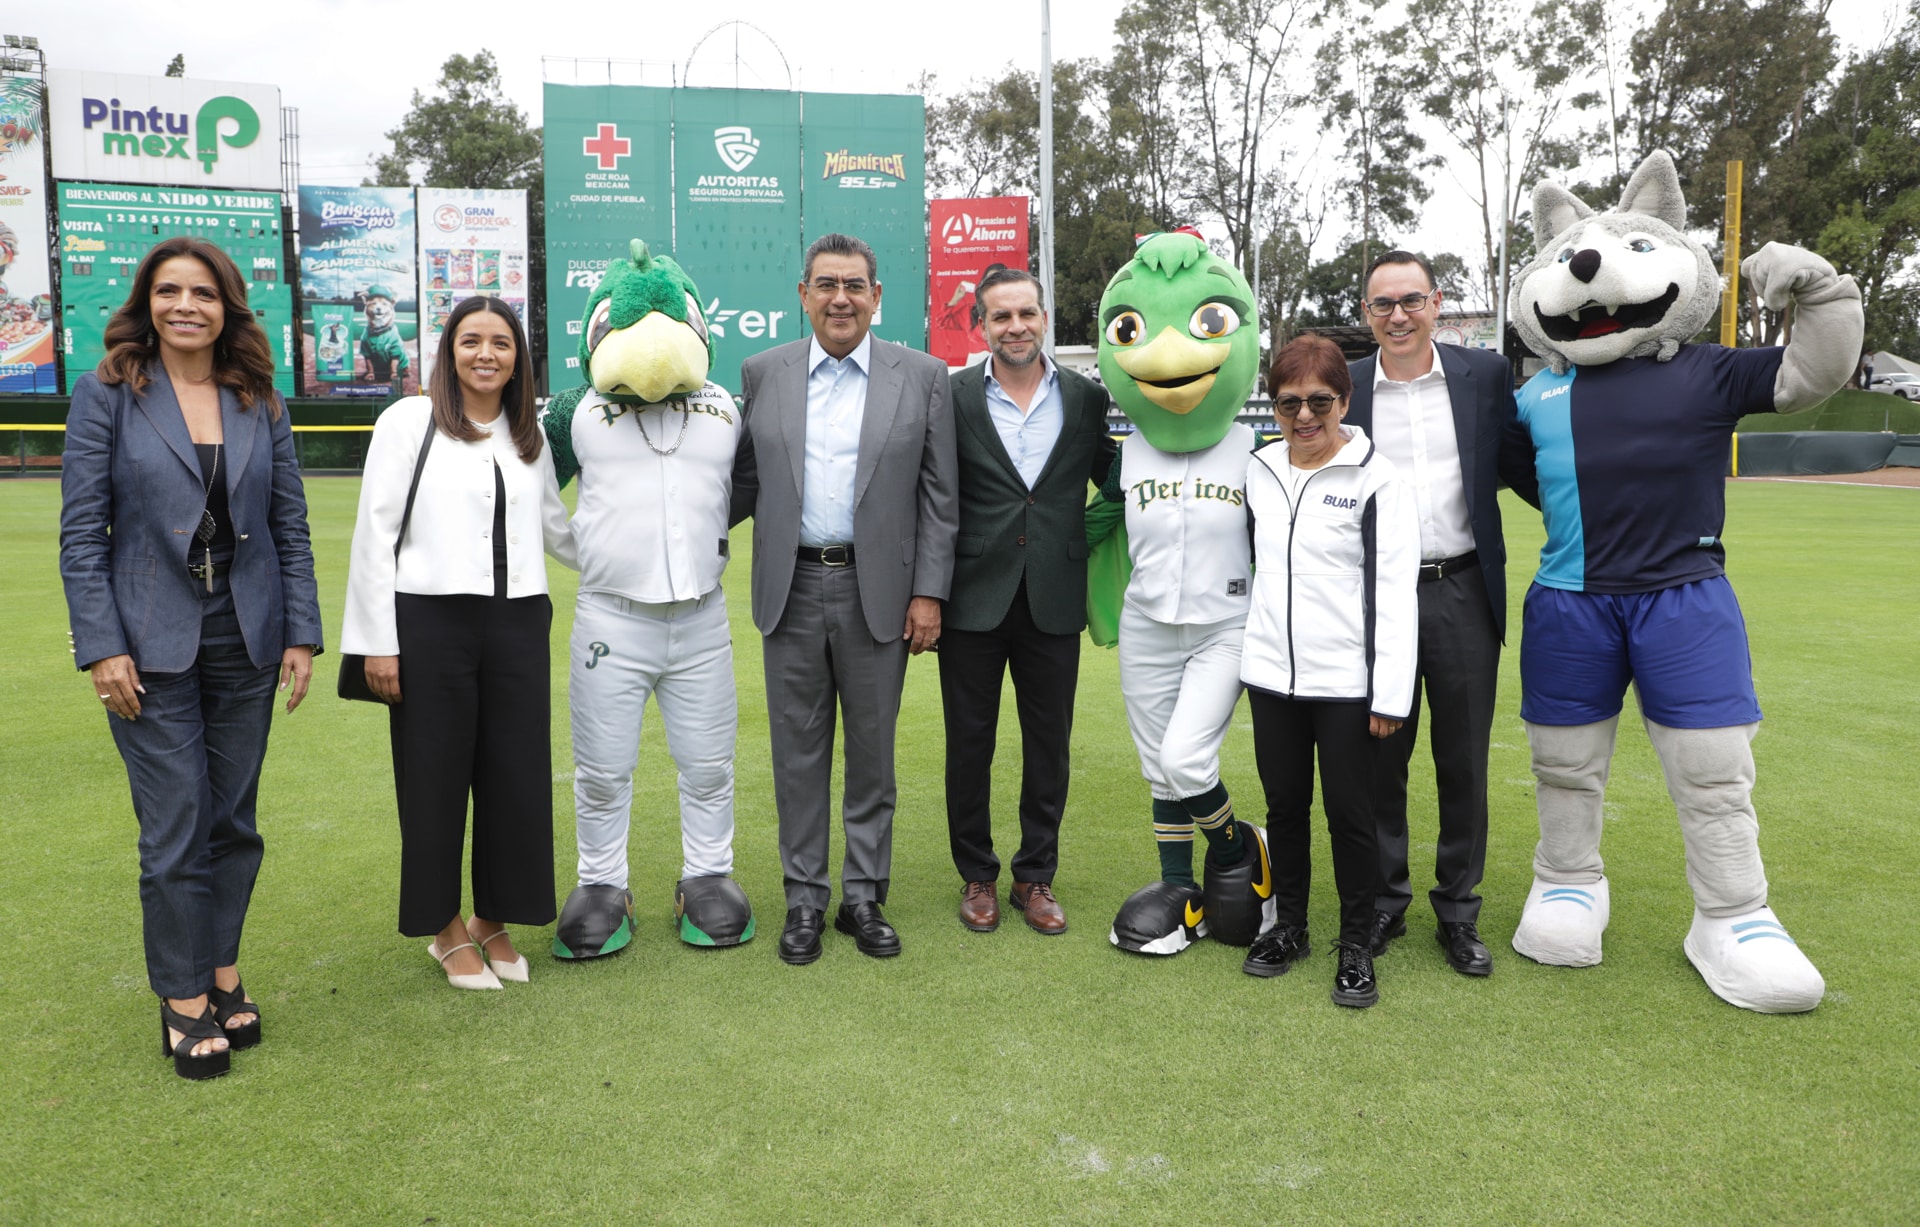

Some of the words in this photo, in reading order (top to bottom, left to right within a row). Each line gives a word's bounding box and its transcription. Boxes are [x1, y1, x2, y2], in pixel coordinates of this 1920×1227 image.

[82, 98, 189, 135] Pintu
[103, 132, 190, 160] mex
[585, 173, 607, 181] CRUZ
[697, 175, 779, 188] AUTORITAS
[585, 181, 630, 189] MEXICANA
[570, 194, 600, 202] CIUDAD
[613, 195, 646, 203] PUEBLA
[689, 187, 742, 197] SEGURIDAD
[743, 189, 784, 197] PRIVADA
[66, 189, 138, 202] BIENVENIDOS
[140, 192, 155, 203] AL
[158, 192, 209, 206] NIDO
[212, 194, 275, 209] VERDE
[464, 207, 495, 216] GRAN
[63, 220, 104, 232] VISITA
[106, 213, 113, 222] 1
[117, 213, 125, 222] 2
[128, 214, 136, 223] 3
[140, 214, 148, 223] 4
[151, 215, 159, 224] 5
[162, 216, 171, 224] 6
[173, 216, 181, 225] 7
[184, 216, 193, 225] 8
[195, 217, 204, 225] 9
[206, 217, 219, 227] 10
[228, 218, 237, 227] C
[252, 219, 260, 228] H
[271, 219, 279, 229] E
[367, 216, 395, 230] pro
[464, 216, 511, 226] BODEGA
[975, 216, 1005, 225] Farmacias
[1007, 216, 1017, 224] del
[970, 227, 1016, 241] Ahorro
[319, 236, 398, 252] ALIMENTO
[341, 248, 377, 257] PARA
[67, 255, 79, 263] AL
[79, 255, 96, 263] BAT
[110, 256, 137, 264] BOLAS
[253, 257, 276, 269] MPH
[307, 257, 409, 273] CAMPEONES
[1323, 494, 1357, 510] BUAP
